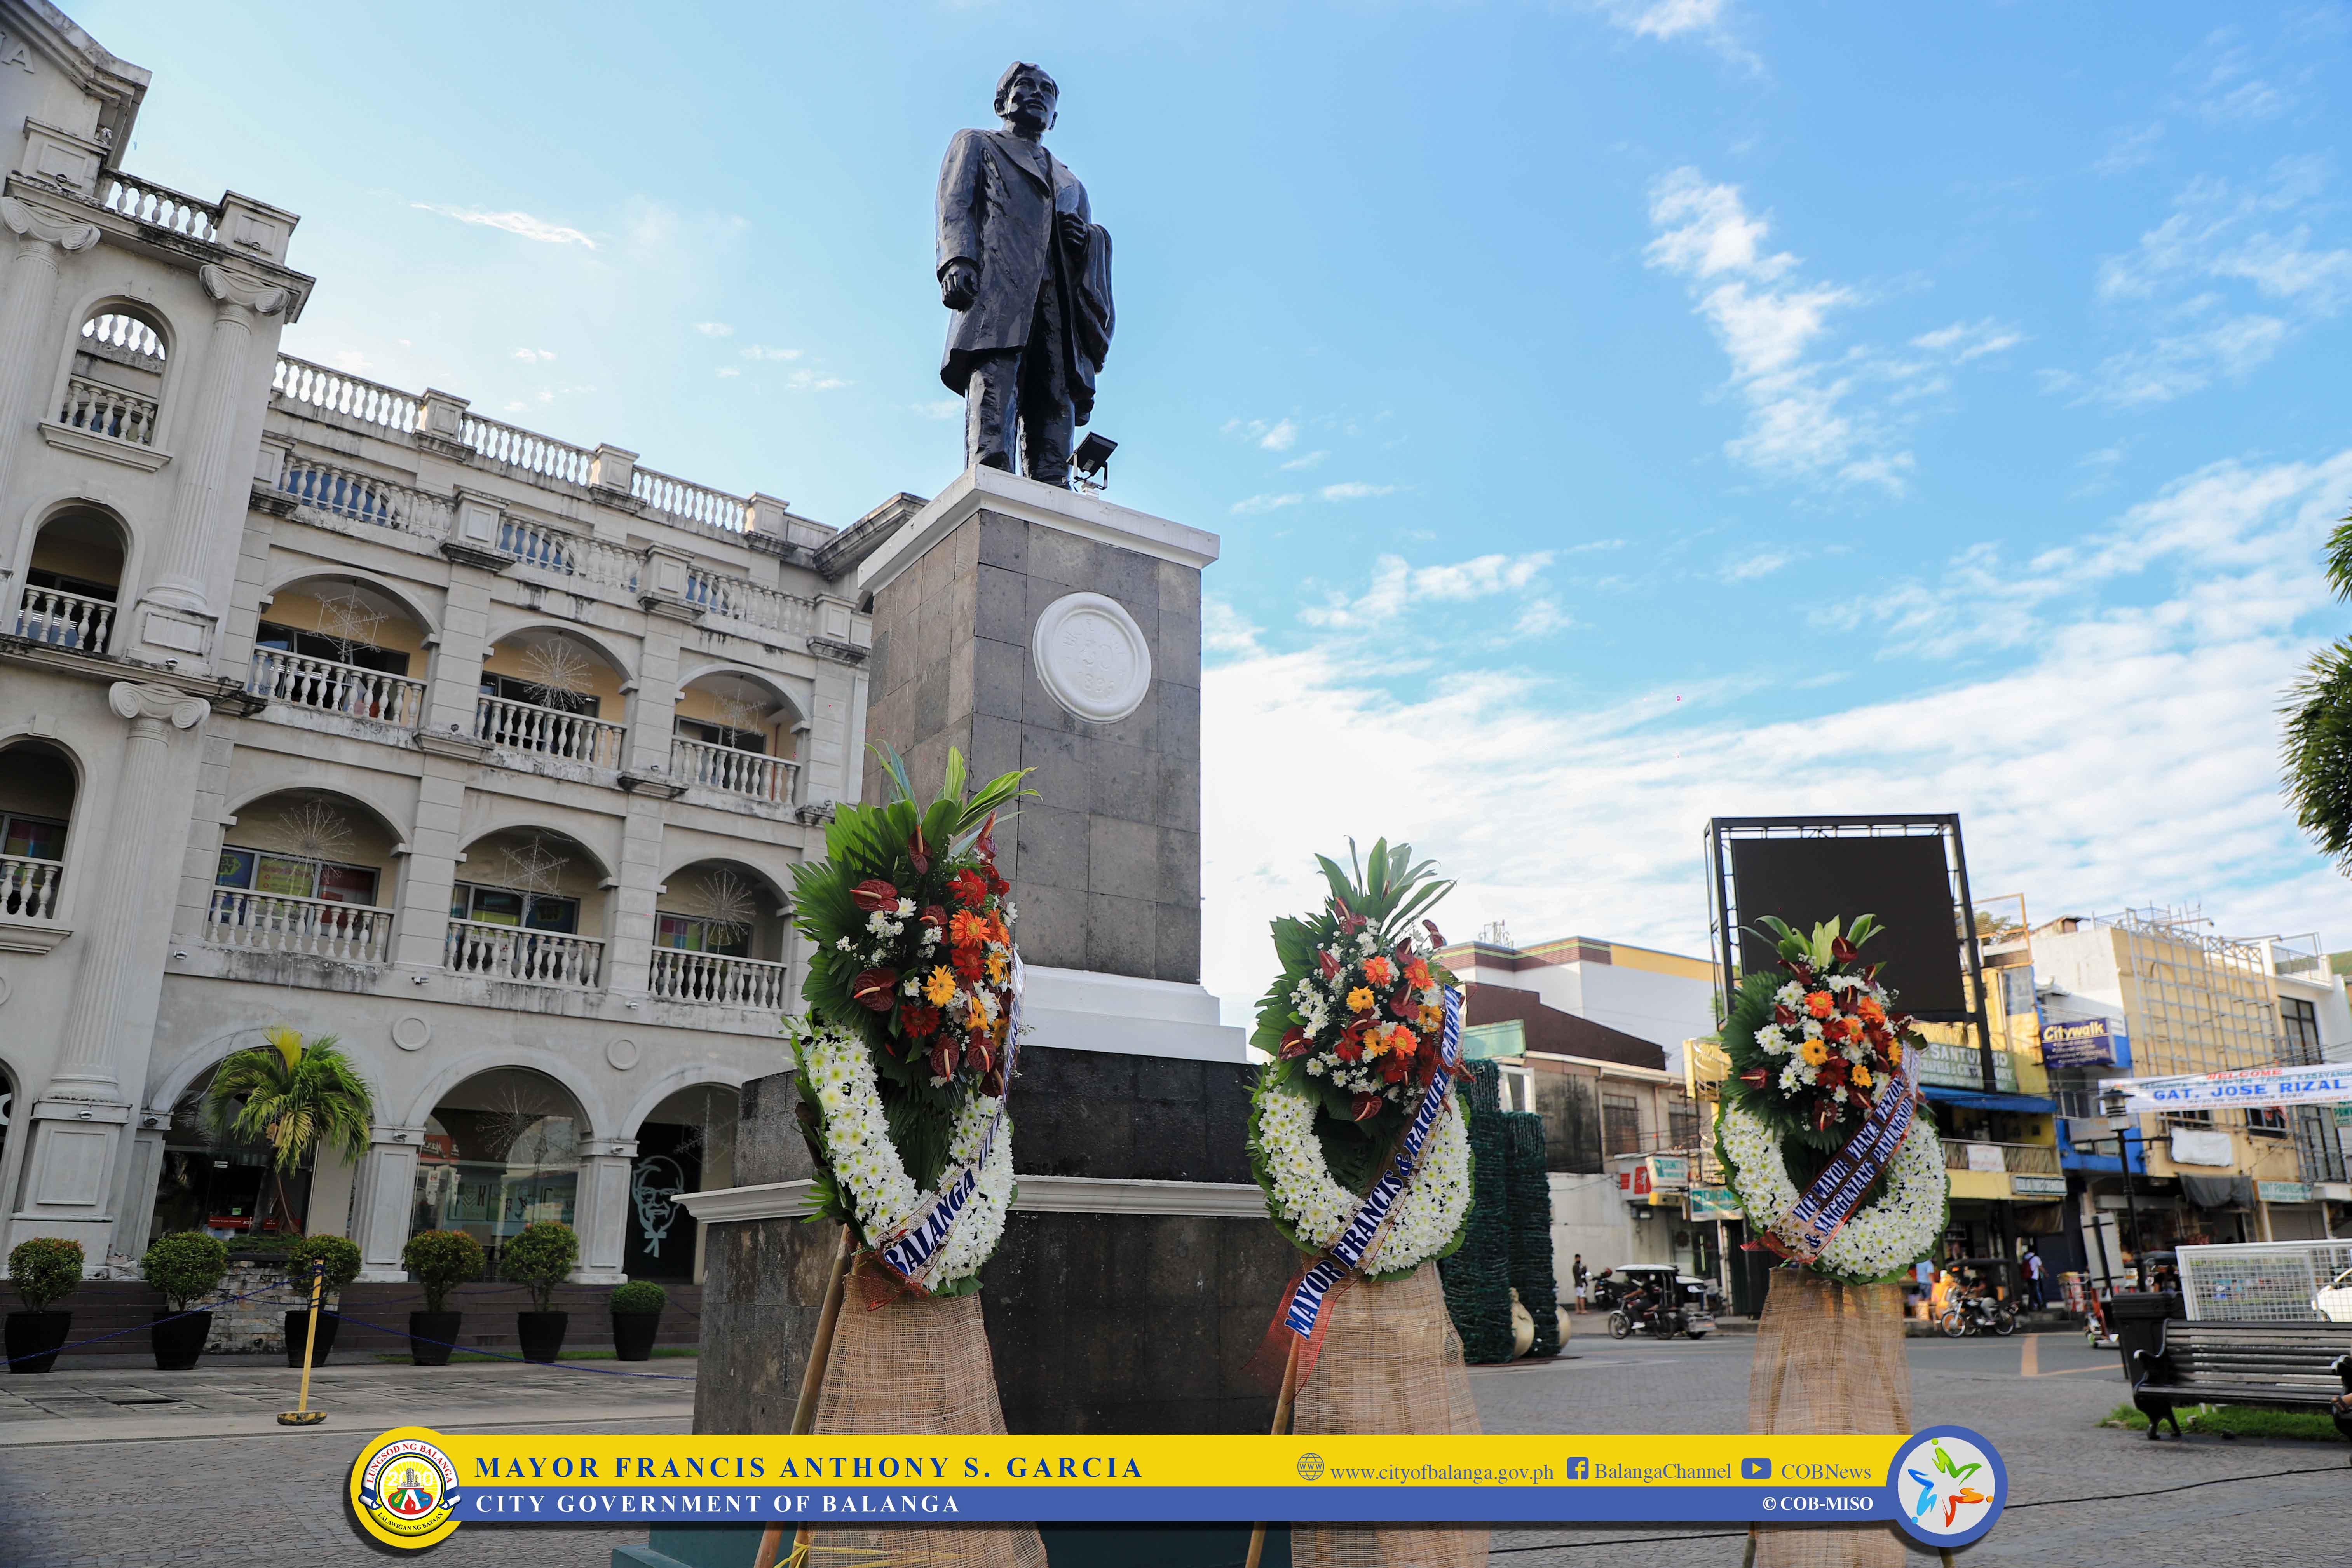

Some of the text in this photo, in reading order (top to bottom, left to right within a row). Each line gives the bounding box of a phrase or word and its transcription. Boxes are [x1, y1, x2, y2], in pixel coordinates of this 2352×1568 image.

[1930, 1043, 2008, 1068] SANTUIO
[2043, 1021, 2104, 1041] Citywalk
[2154, 1080, 2348, 1100] GAT. JOSE RIZAL
[2207, 1069, 2282, 1080] WELCOME
[1284, 983, 1461, 1340] MAYOR FRANCIS & RAQUEL GARCIA
[1793, 1192, 1821, 1222] VICE
[1812, 1158, 1852, 1200] MAYOR
[1846, 1119, 1881, 1162] VIANCA
[1805, 1234, 1821, 1248] &
[1814, 1160, 1876, 1236] SANGGUNIANG
[1871, 1097, 1914, 1165] PANLUNGSOD
[884, 1169, 976, 1276] BALANGA
